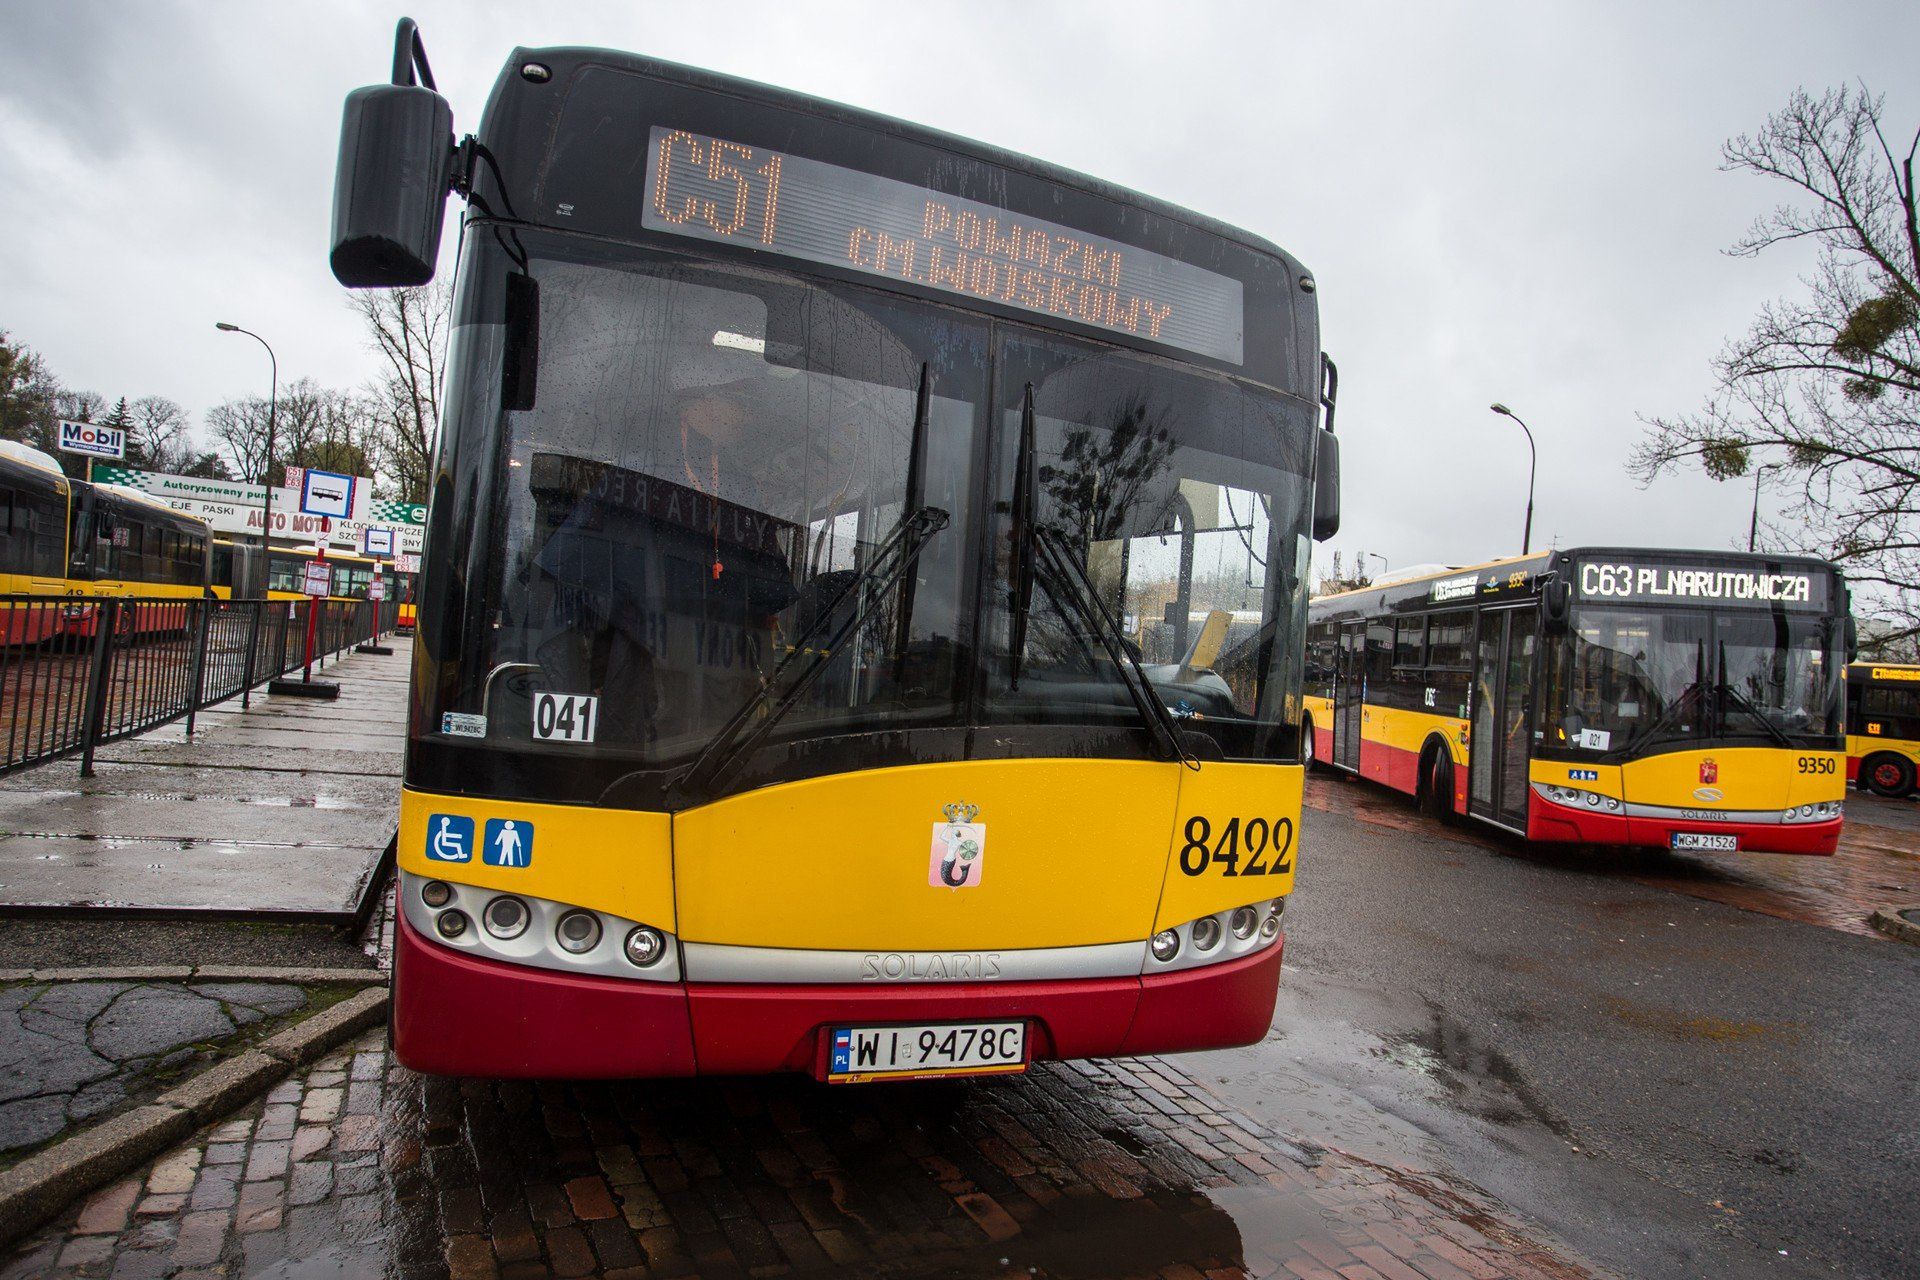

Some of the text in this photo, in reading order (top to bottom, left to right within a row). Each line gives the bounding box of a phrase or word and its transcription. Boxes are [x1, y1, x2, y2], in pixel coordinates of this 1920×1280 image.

[653, 130, 783, 246] C51
[63, 423, 121, 447] Mobil
[163, 480, 243, 499] Autoryzowany
[165, 501, 234, 515] EJE PASKI
[246, 510, 286, 531] AUTO
[338, 531, 358, 541] SZC
[1581, 563, 1633, 597] C63
[537, 694, 592, 740] 041
[1589, 733, 1600, 747] 021
[1797, 757, 1836, 775] 9350
[1680, 809, 1728, 821] SOLARIS
[1178, 816, 1295, 878] 8422
[1678, 835, 1699, 846] WGM
[1702, 836, 1735, 848] 21526
[860, 953, 1001, 981] SOLARIS
[835, 1027, 1018, 1066] PL WI 9478C
